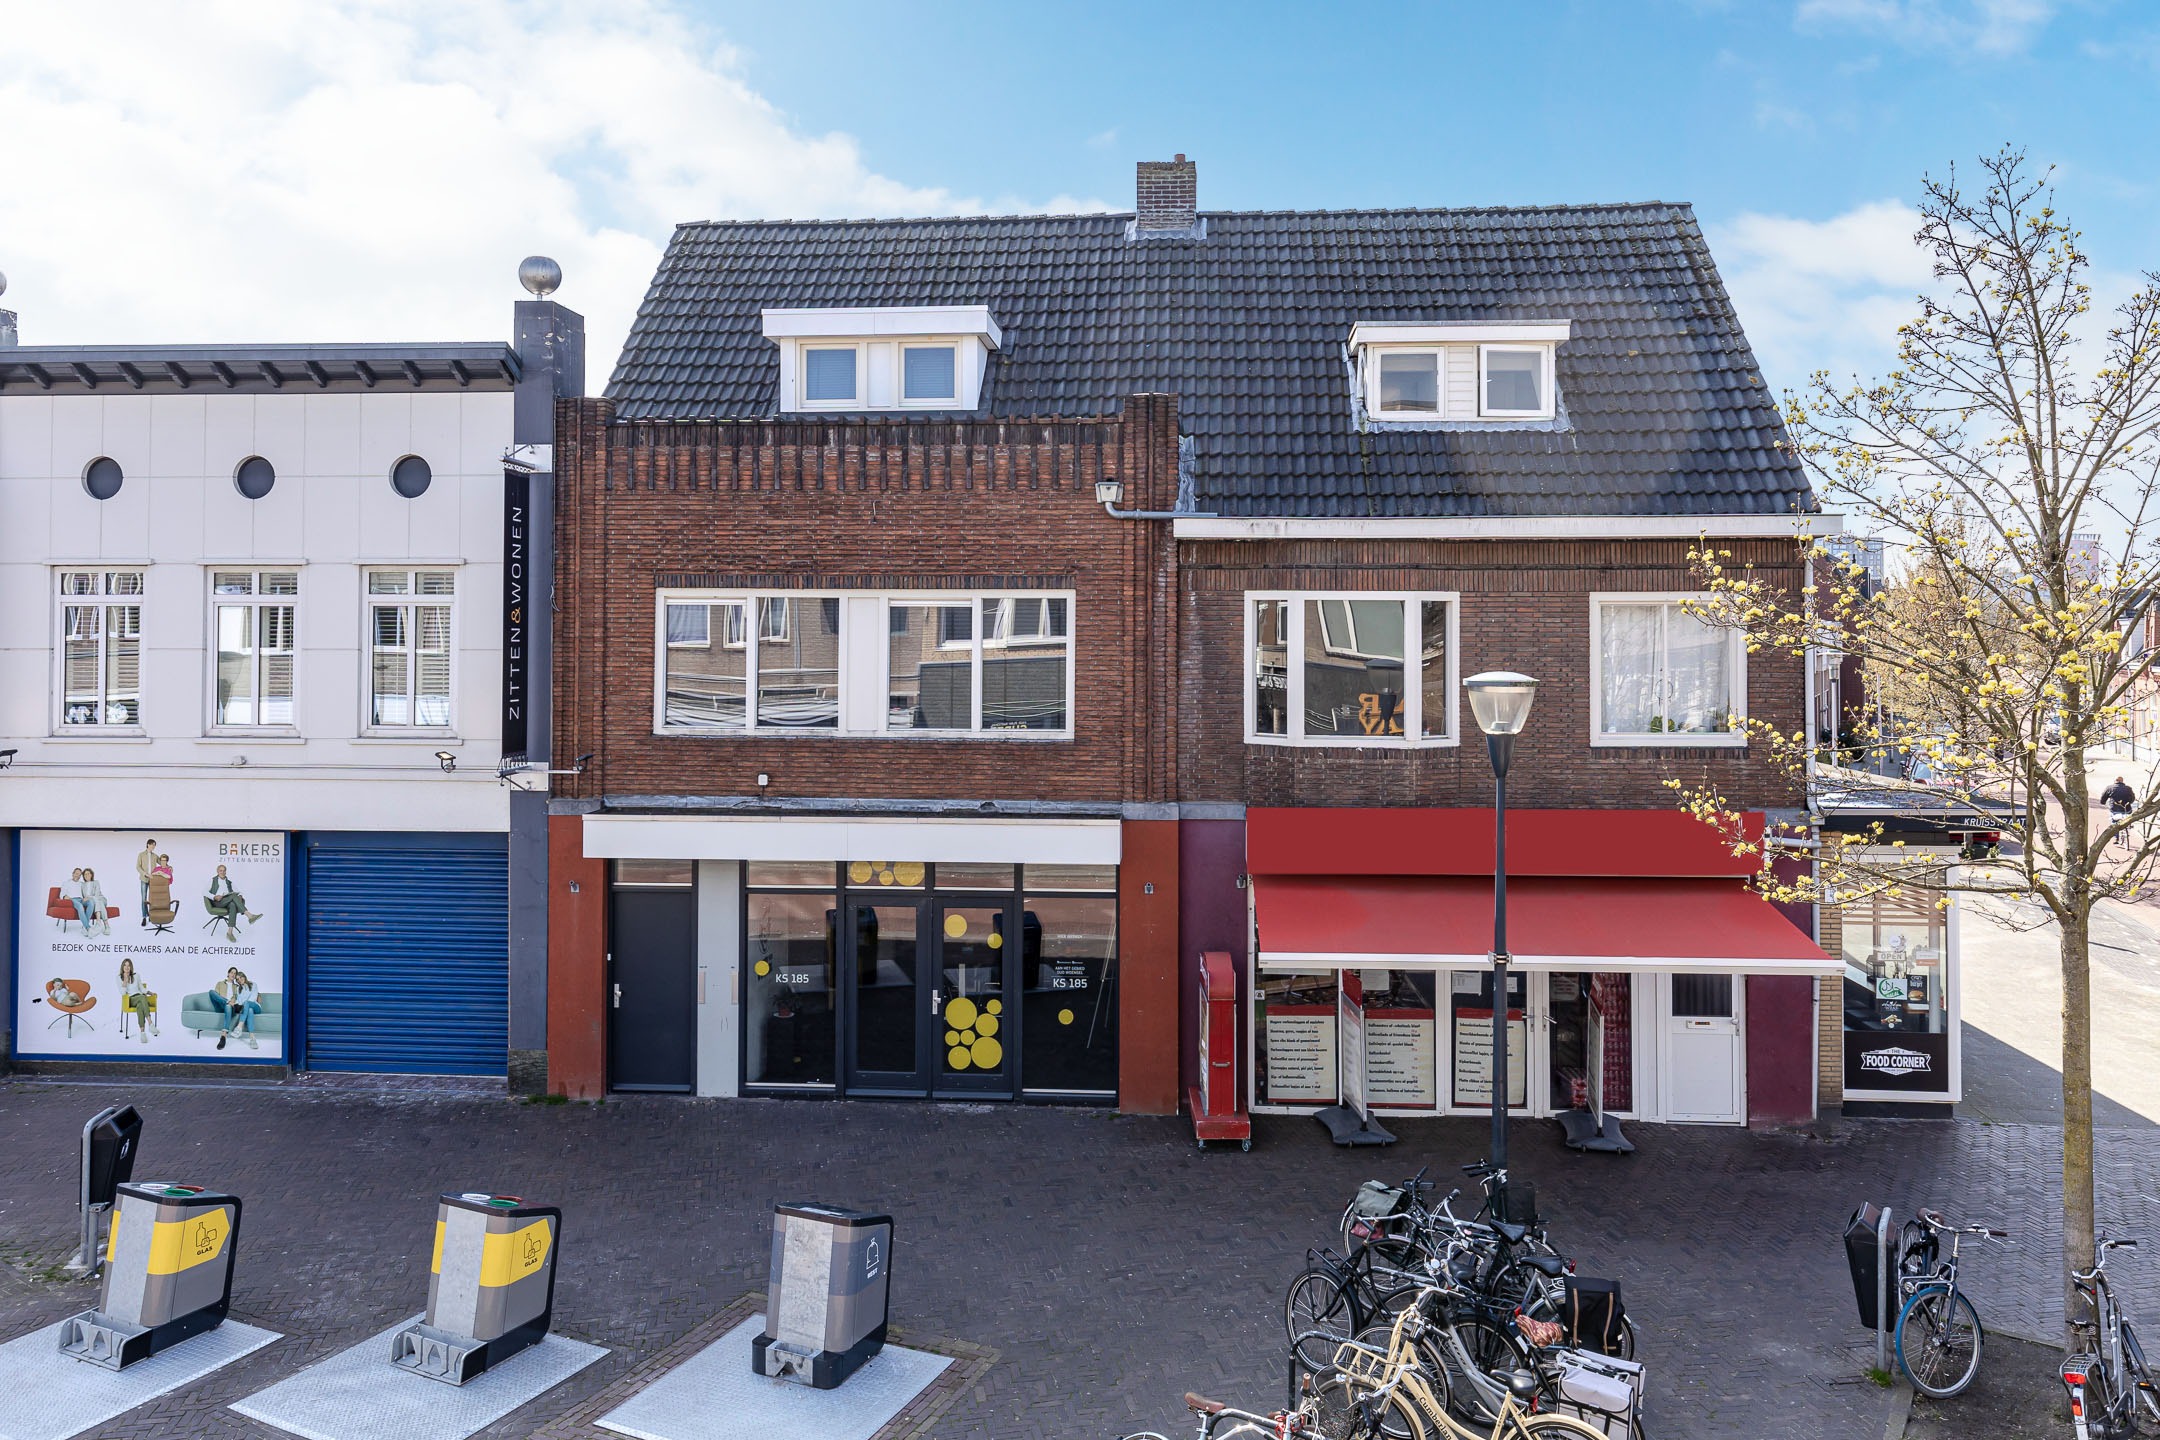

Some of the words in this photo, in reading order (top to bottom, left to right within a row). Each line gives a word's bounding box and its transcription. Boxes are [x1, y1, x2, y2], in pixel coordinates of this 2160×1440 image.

[1963, 817, 2026, 827] KRUISSRAAT
[219, 843, 280, 856] BAKERS
[51, 943, 84, 952] BEZOEK
[86, 944, 111, 953] ONZE
[113, 944, 162, 954] EETKAMERS
[164, 946, 185, 954] AAN
[187, 946, 199, 954] DE
[202, 946, 256, 956] ACHTERZIJDE
[775, 973, 789, 983] KS
[791, 973, 810, 983] 185
[1053, 978, 1067, 988] KS
[1068, 978, 1088, 989] 185
[1866, 1055, 1890, 1067] FOOD
[1890, 1056, 1926, 1068] CORNER
[196, 1245, 213, 1256] GLAS
[524, 1257, 538, 1267] GLAS
